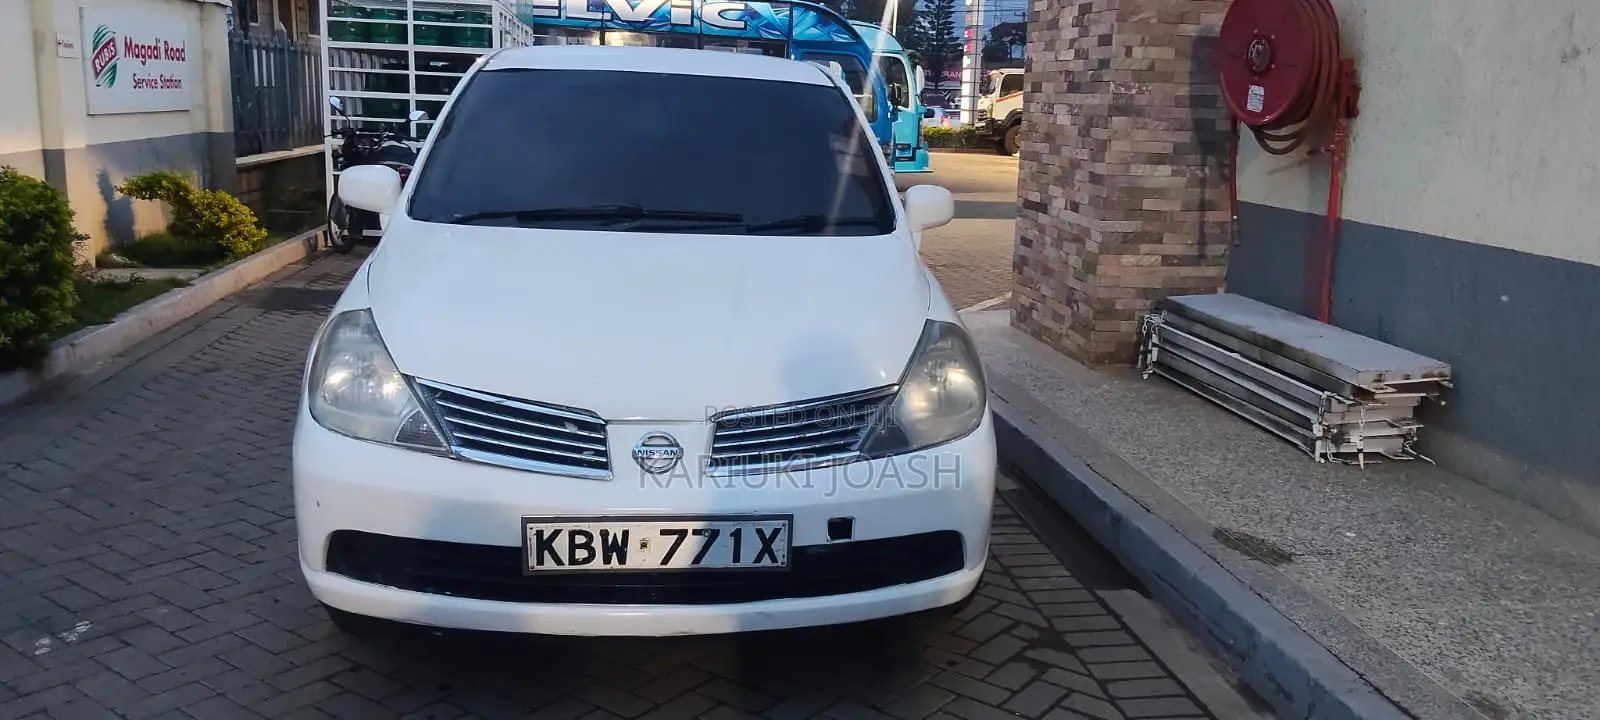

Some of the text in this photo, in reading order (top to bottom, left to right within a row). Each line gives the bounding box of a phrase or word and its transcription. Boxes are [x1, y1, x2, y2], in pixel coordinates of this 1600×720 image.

[94, 40, 117, 73] RUBIS
[124, 36, 186, 66] Magadi Road
[132, 72, 182, 90] Service Station
[637, 449, 678, 457] NISSAN
[533, 527, 783, 567] KBW 771X
